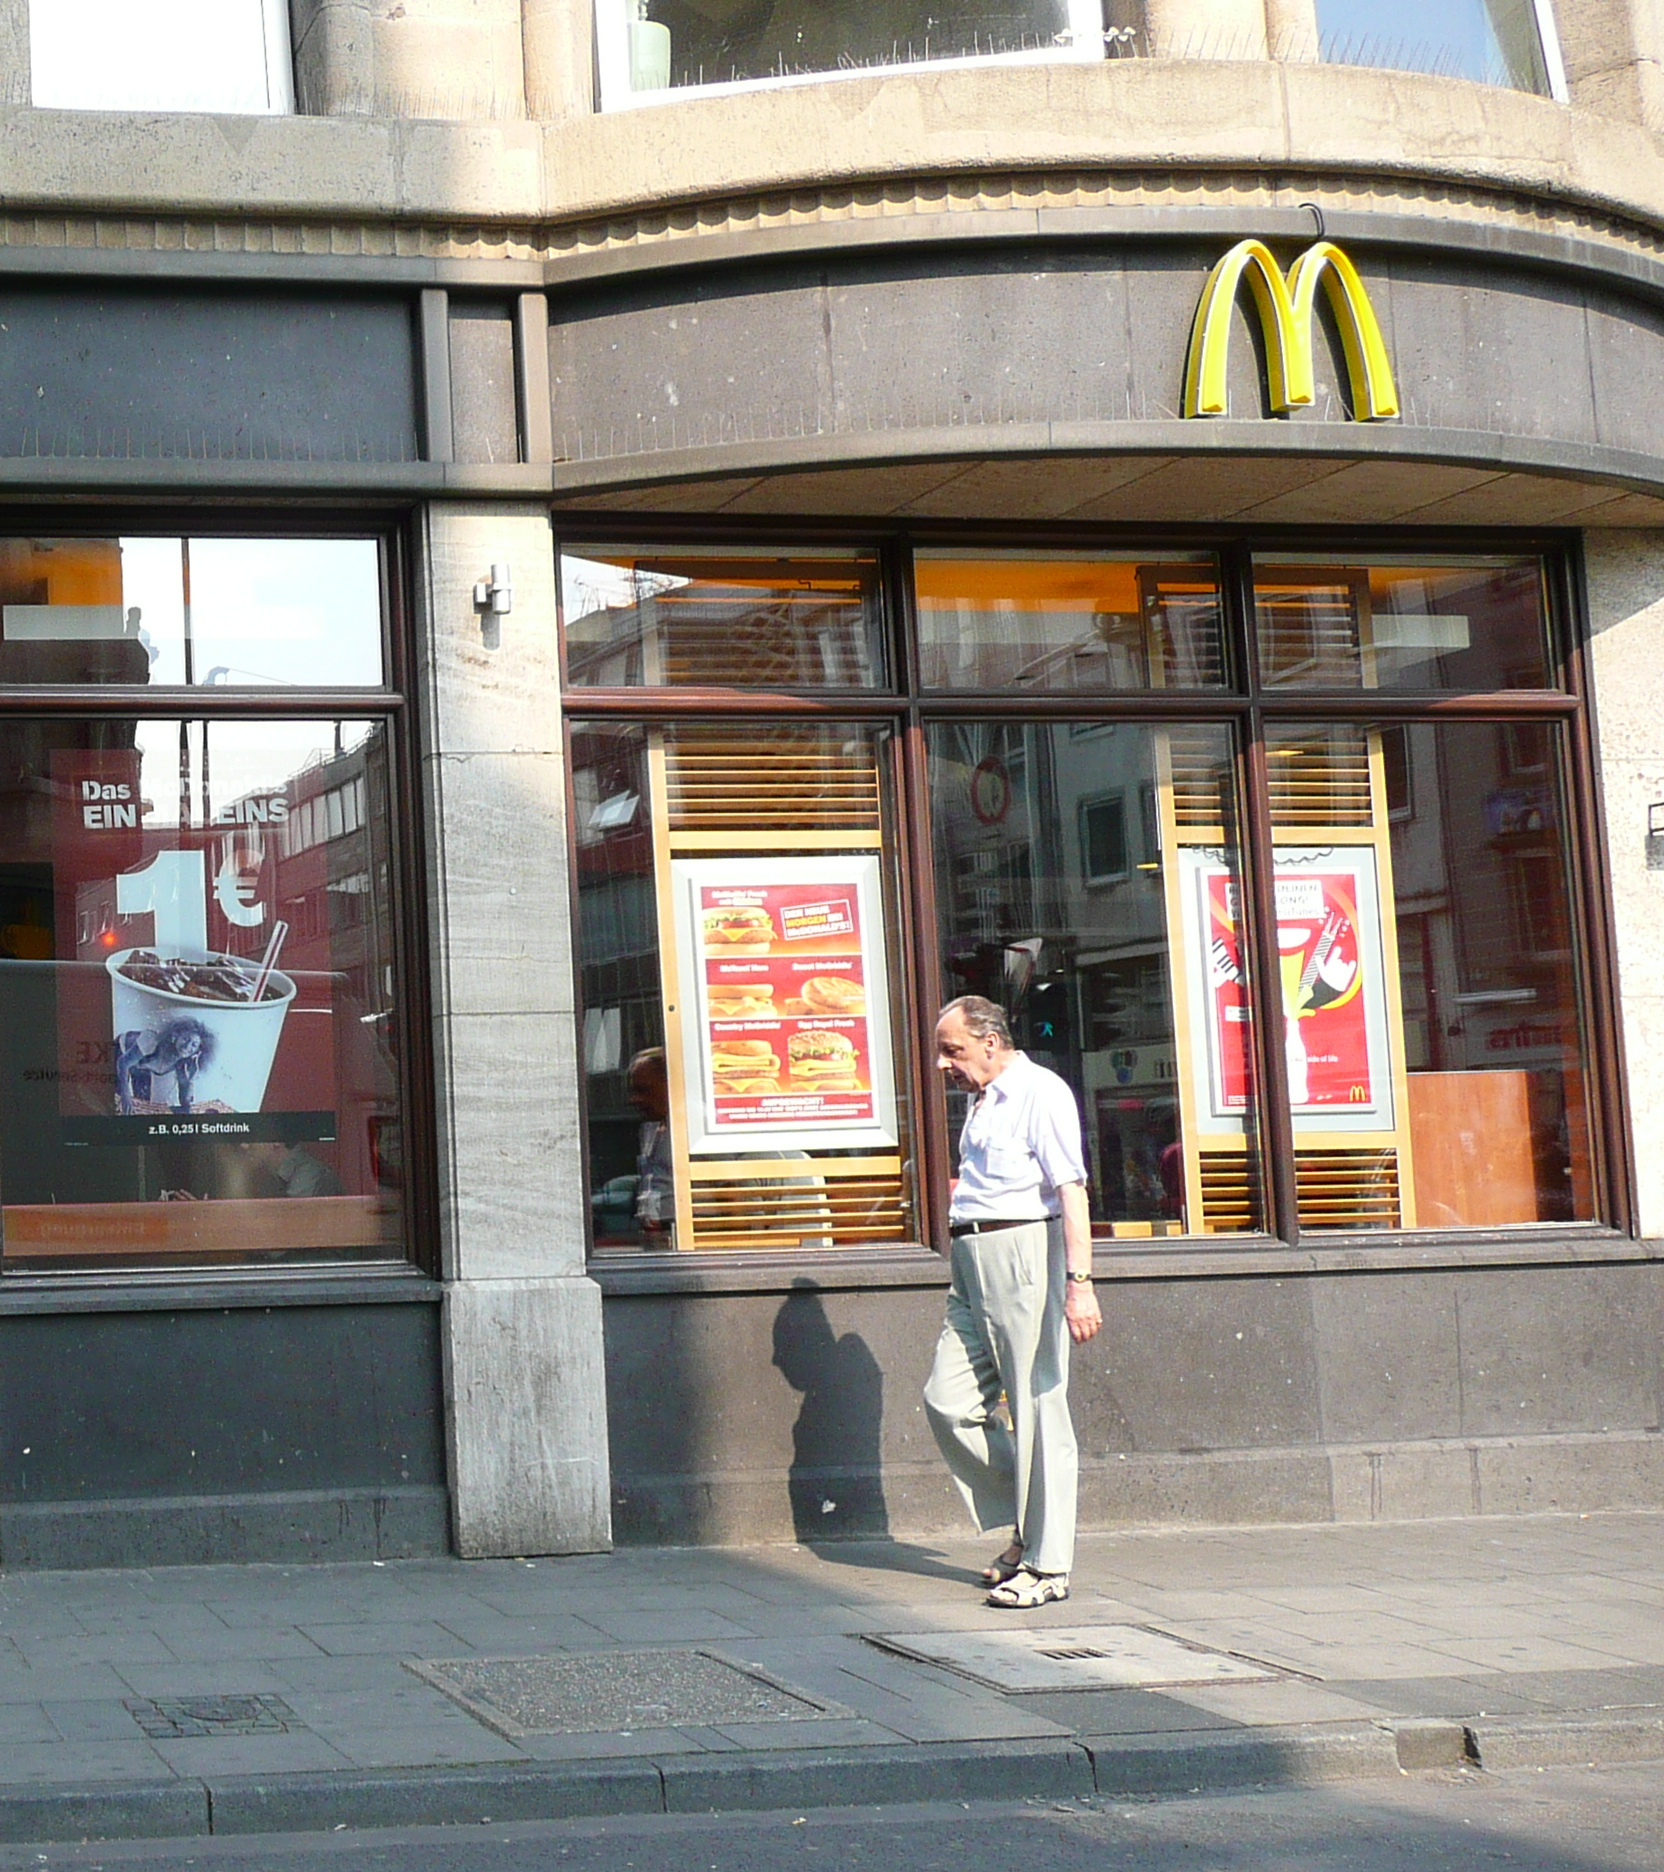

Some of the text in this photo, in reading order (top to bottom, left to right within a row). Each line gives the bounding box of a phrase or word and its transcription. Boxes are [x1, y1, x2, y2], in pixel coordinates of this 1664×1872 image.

[1181, 239, 1400, 422] M
[81, 780, 131, 801] Das
[786, 914, 827, 928] MORGEN
[148, 1124, 170, 1134] z.B.
[172, 1124, 194, 1136] 0,25
[201, 1122, 250, 1134] Softdrink
